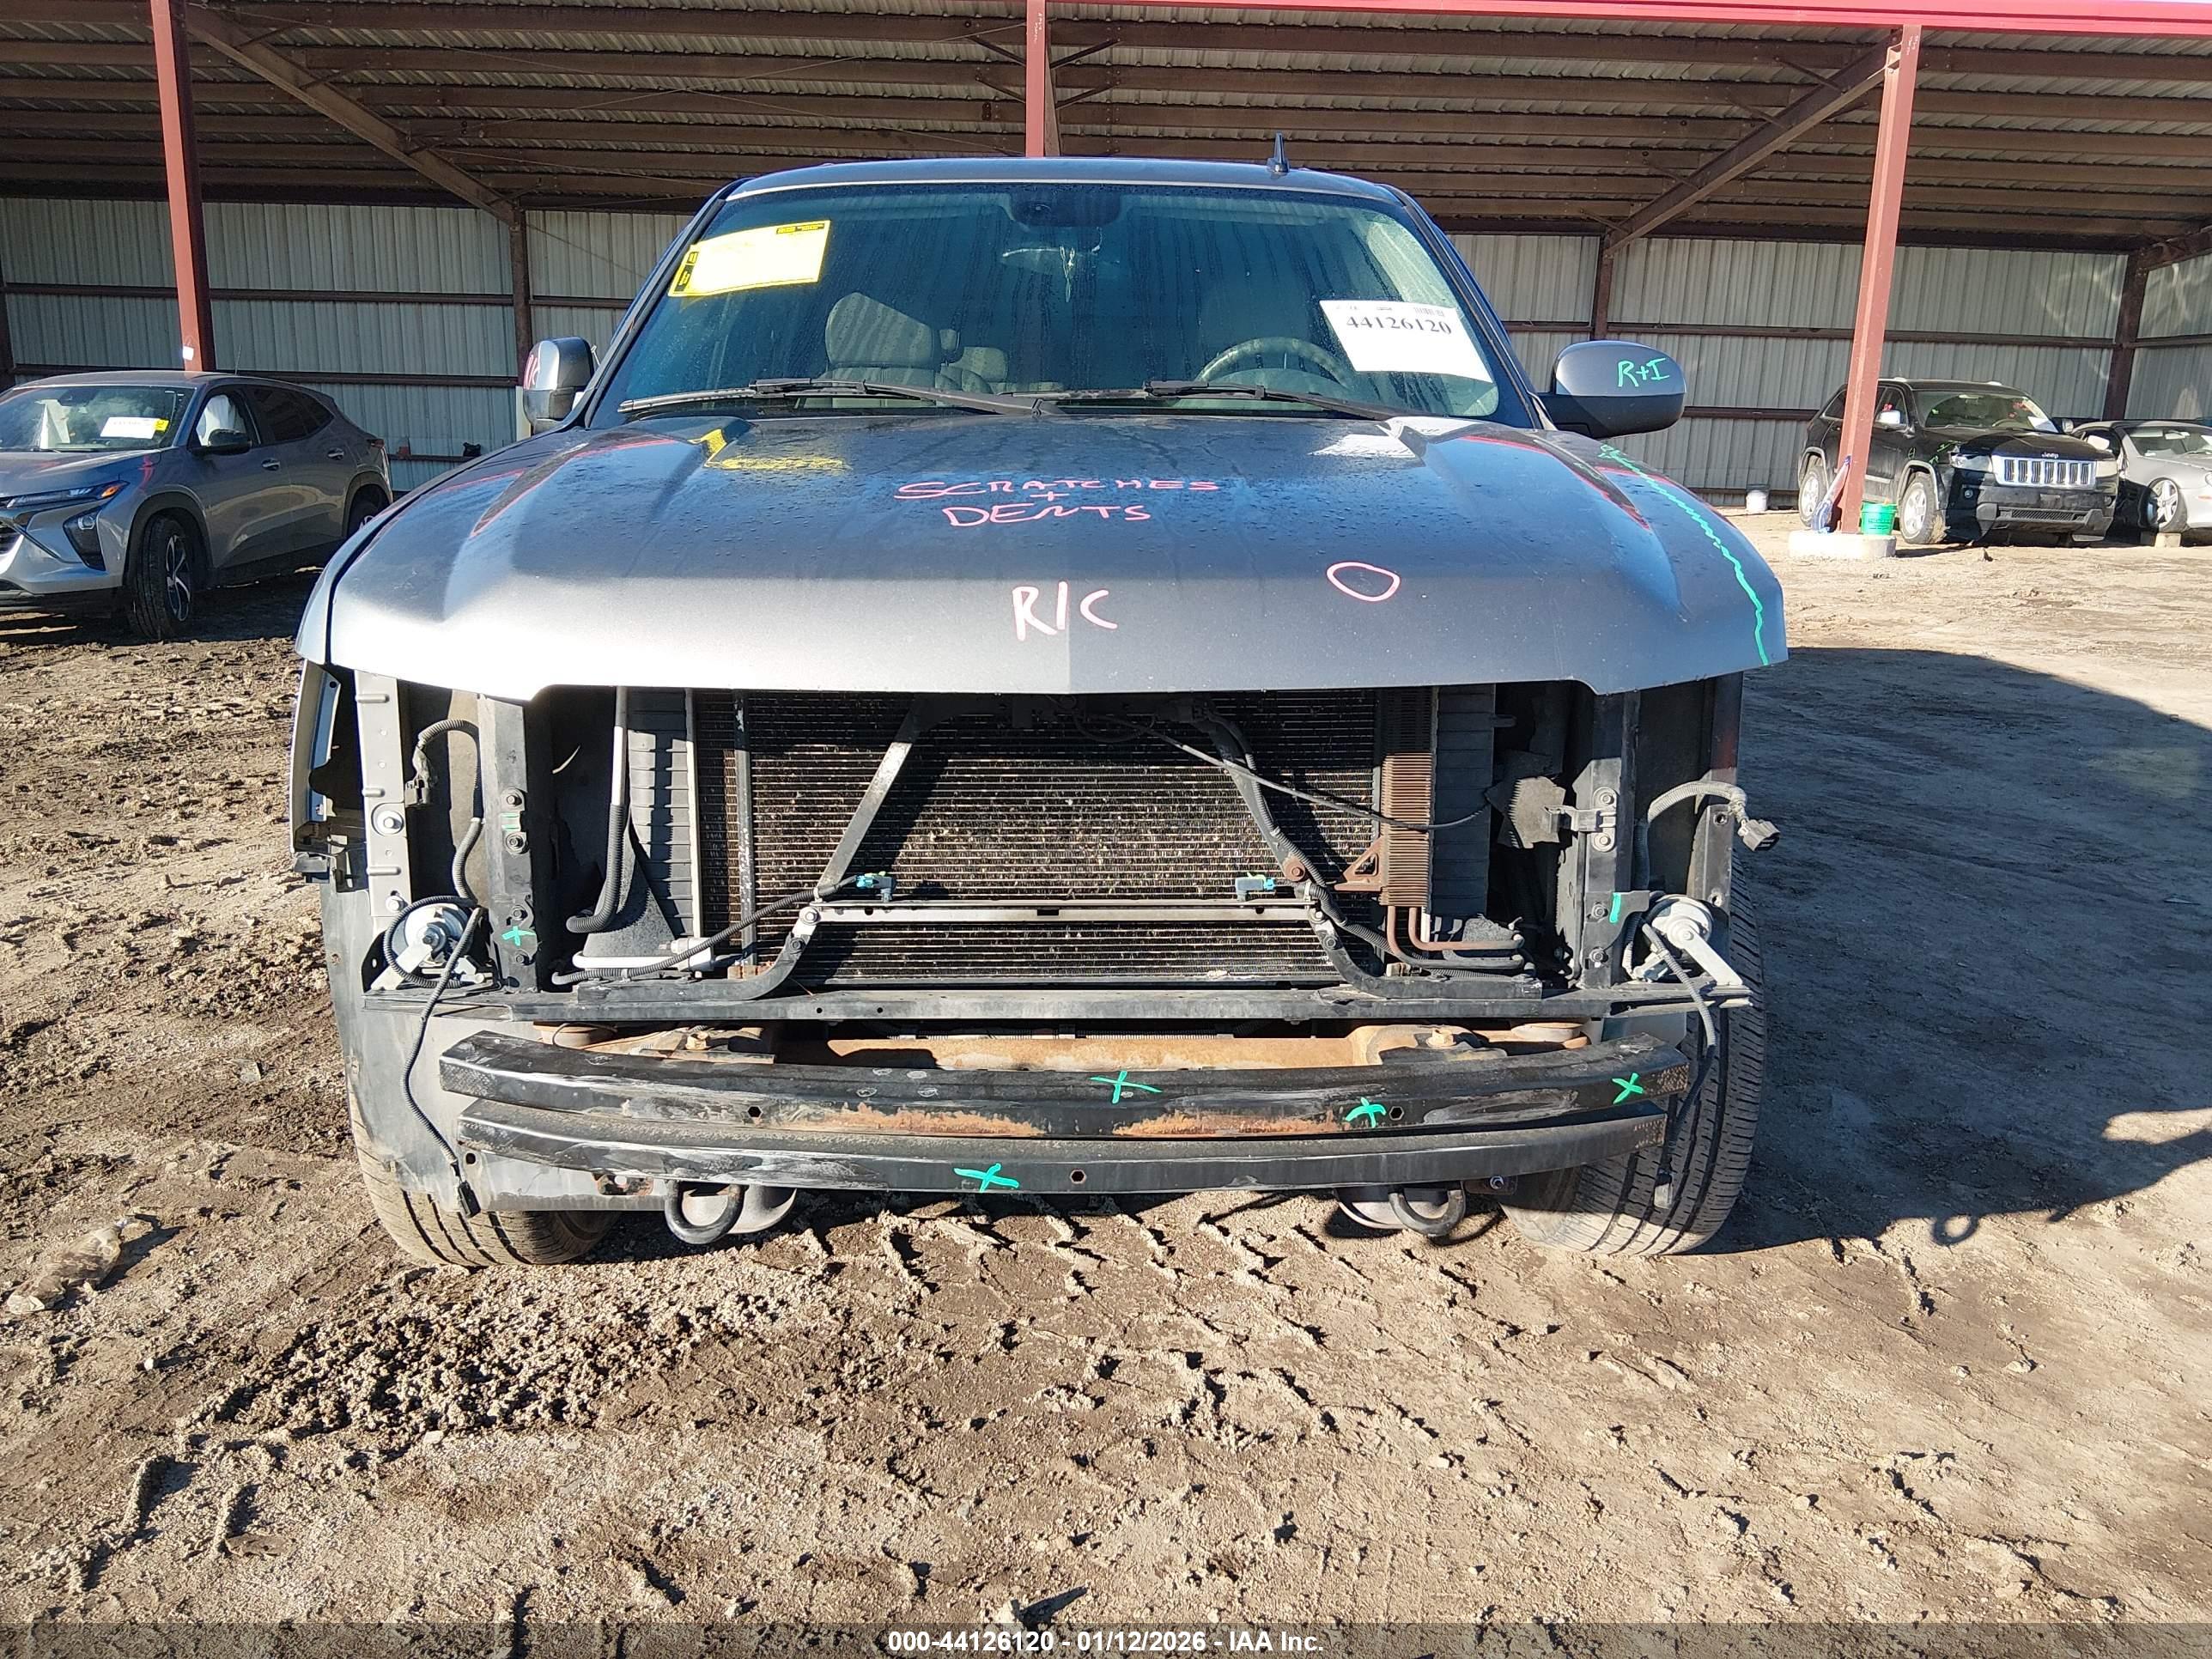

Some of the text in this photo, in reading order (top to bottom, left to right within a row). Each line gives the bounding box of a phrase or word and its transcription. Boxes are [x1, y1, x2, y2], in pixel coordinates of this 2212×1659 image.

[1346, 316, 1452, 335] 44126120
[1618, 358, 1670, 387] R+I
[894, 480, 1218, 499] SCRATCHES
[942, 503, 1151, 526] DENTS
